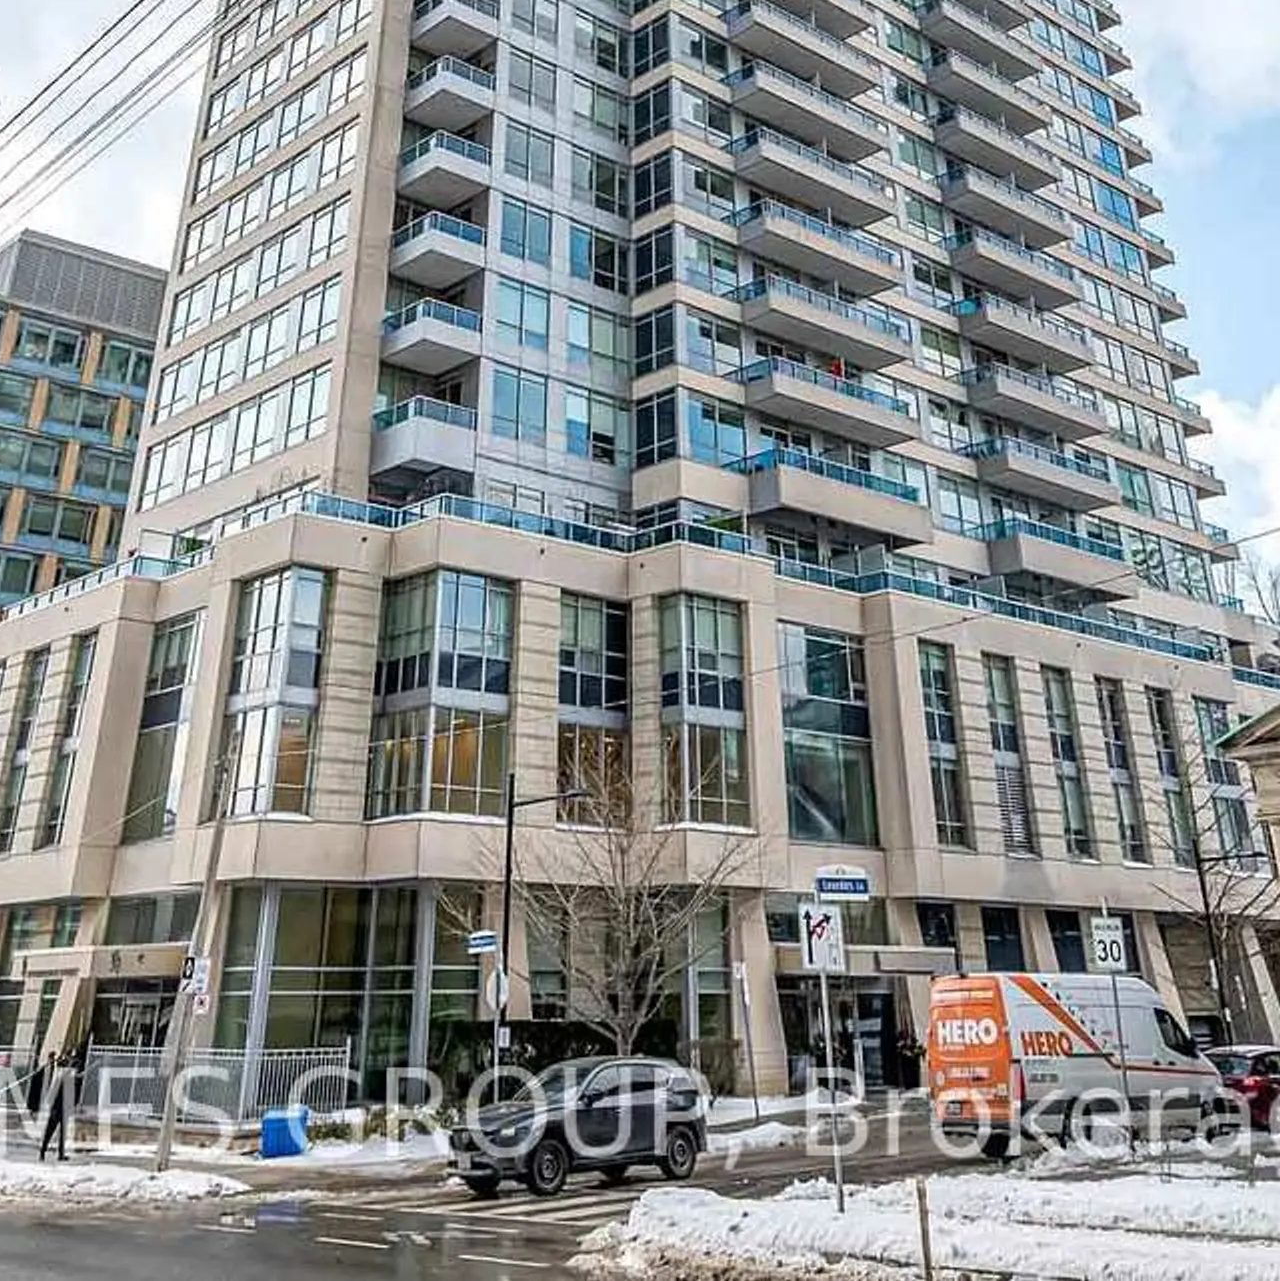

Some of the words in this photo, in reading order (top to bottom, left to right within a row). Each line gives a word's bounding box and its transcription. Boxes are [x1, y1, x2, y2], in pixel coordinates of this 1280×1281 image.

[1097, 939, 1121, 962] 30
[937, 1017, 998, 1045] HERO
[1021, 1030, 1074, 1056] HERO
